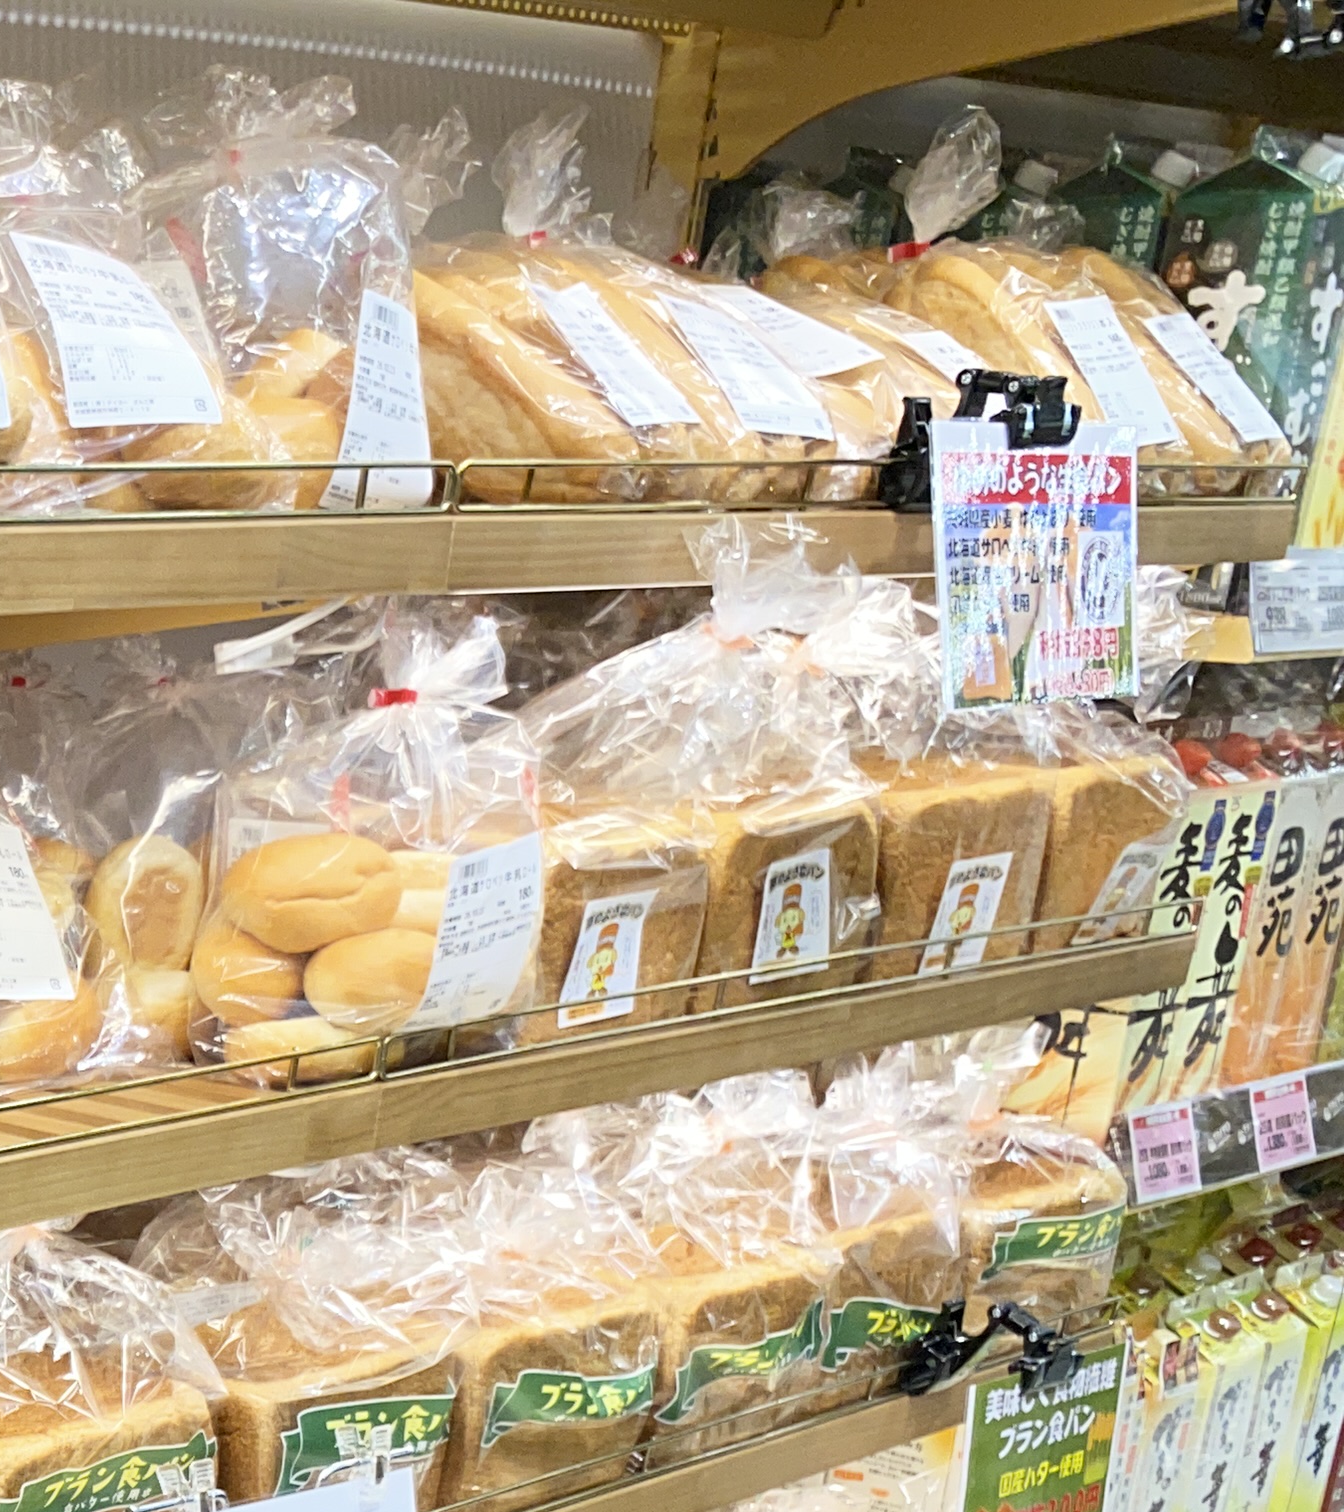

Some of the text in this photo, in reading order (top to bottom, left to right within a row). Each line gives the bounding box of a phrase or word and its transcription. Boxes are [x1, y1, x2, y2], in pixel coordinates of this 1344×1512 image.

[998, 1405, 1097, 1459] ブラン食パン
